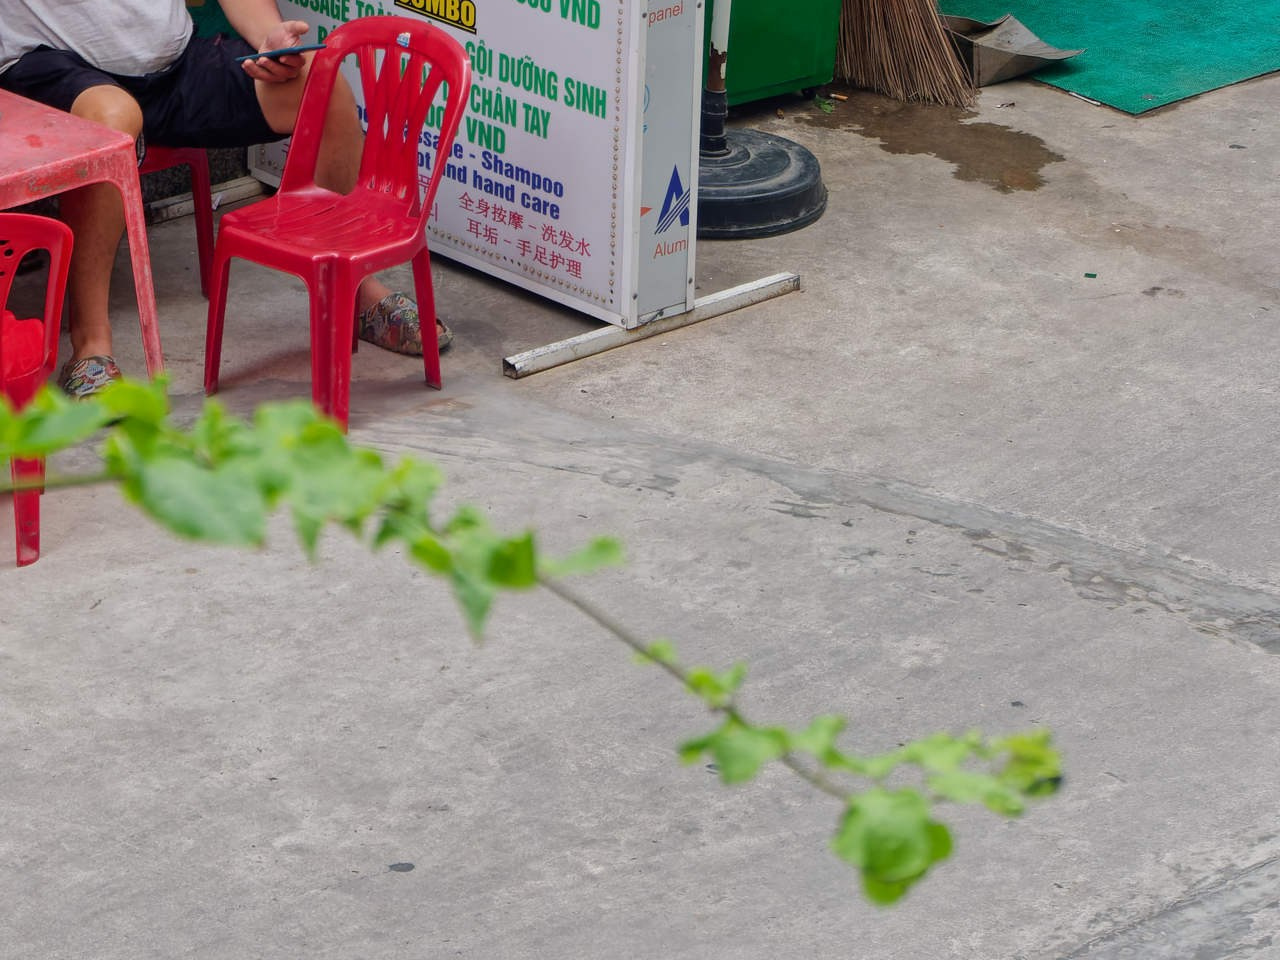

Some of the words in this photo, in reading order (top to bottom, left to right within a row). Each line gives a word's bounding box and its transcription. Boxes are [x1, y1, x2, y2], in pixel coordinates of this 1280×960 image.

[648, 0, 684, 27] panel
[471, 84, 516, 128] CHÂN
[522, 102, 551, 139] TAY
[499, 53, 558, 102] DƯỠNG
[564, 77, 607, 119] SINH
[466, 115, 506, 154] VND
[473, 170, 515, 203] hand
[521, 192, 560, 220] care
[481, 151, 564, 198] Shampoo
[459, 192, 524, 230] 全身按摩
[542, 223, 591, 257] 洗发水
[466, 218, 499, 245] 耳垢
[517, 239, 583, 279] 手足护理
